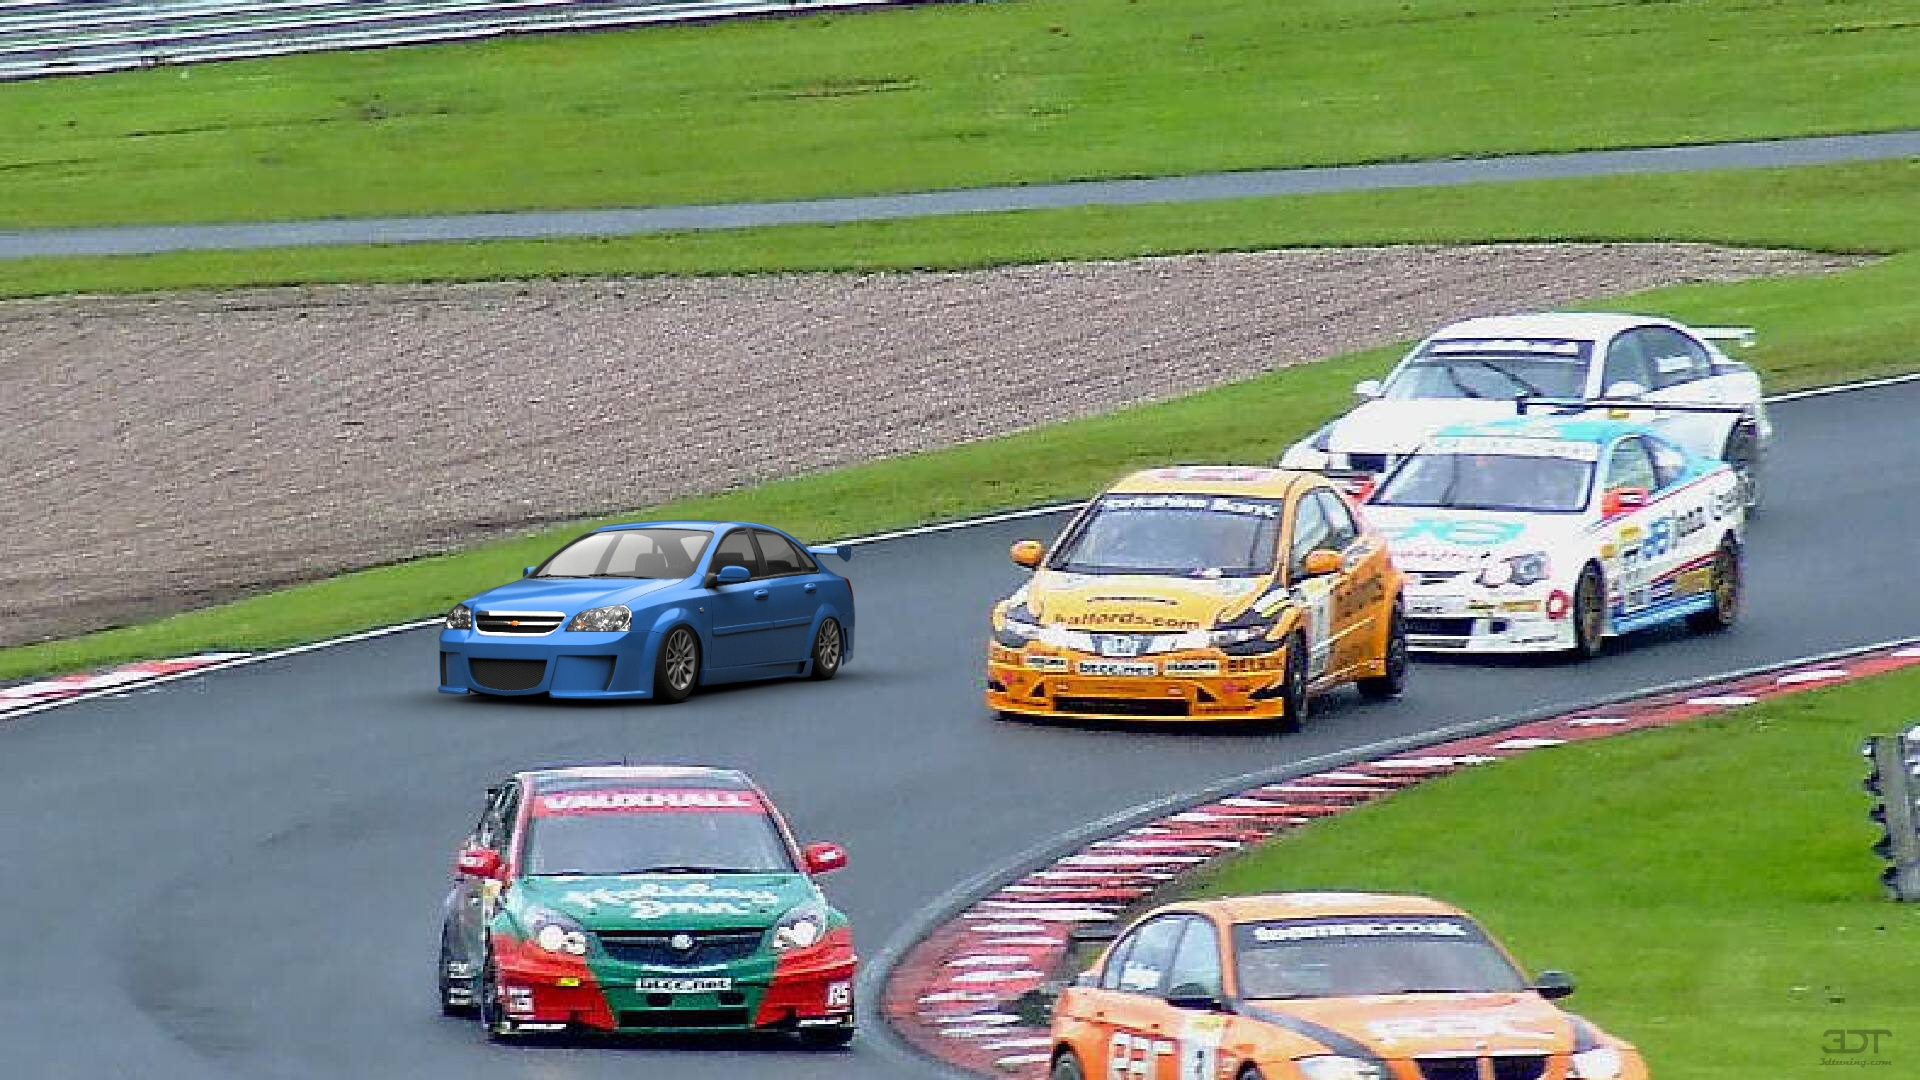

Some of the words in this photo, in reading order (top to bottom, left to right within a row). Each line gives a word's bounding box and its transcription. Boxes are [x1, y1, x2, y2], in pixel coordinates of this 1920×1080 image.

[1079, 661, 1156, 676] btcc.net
[544, 792, 751, 809] VAUXHALL
[639, 978, 729, 991] btcc.net
